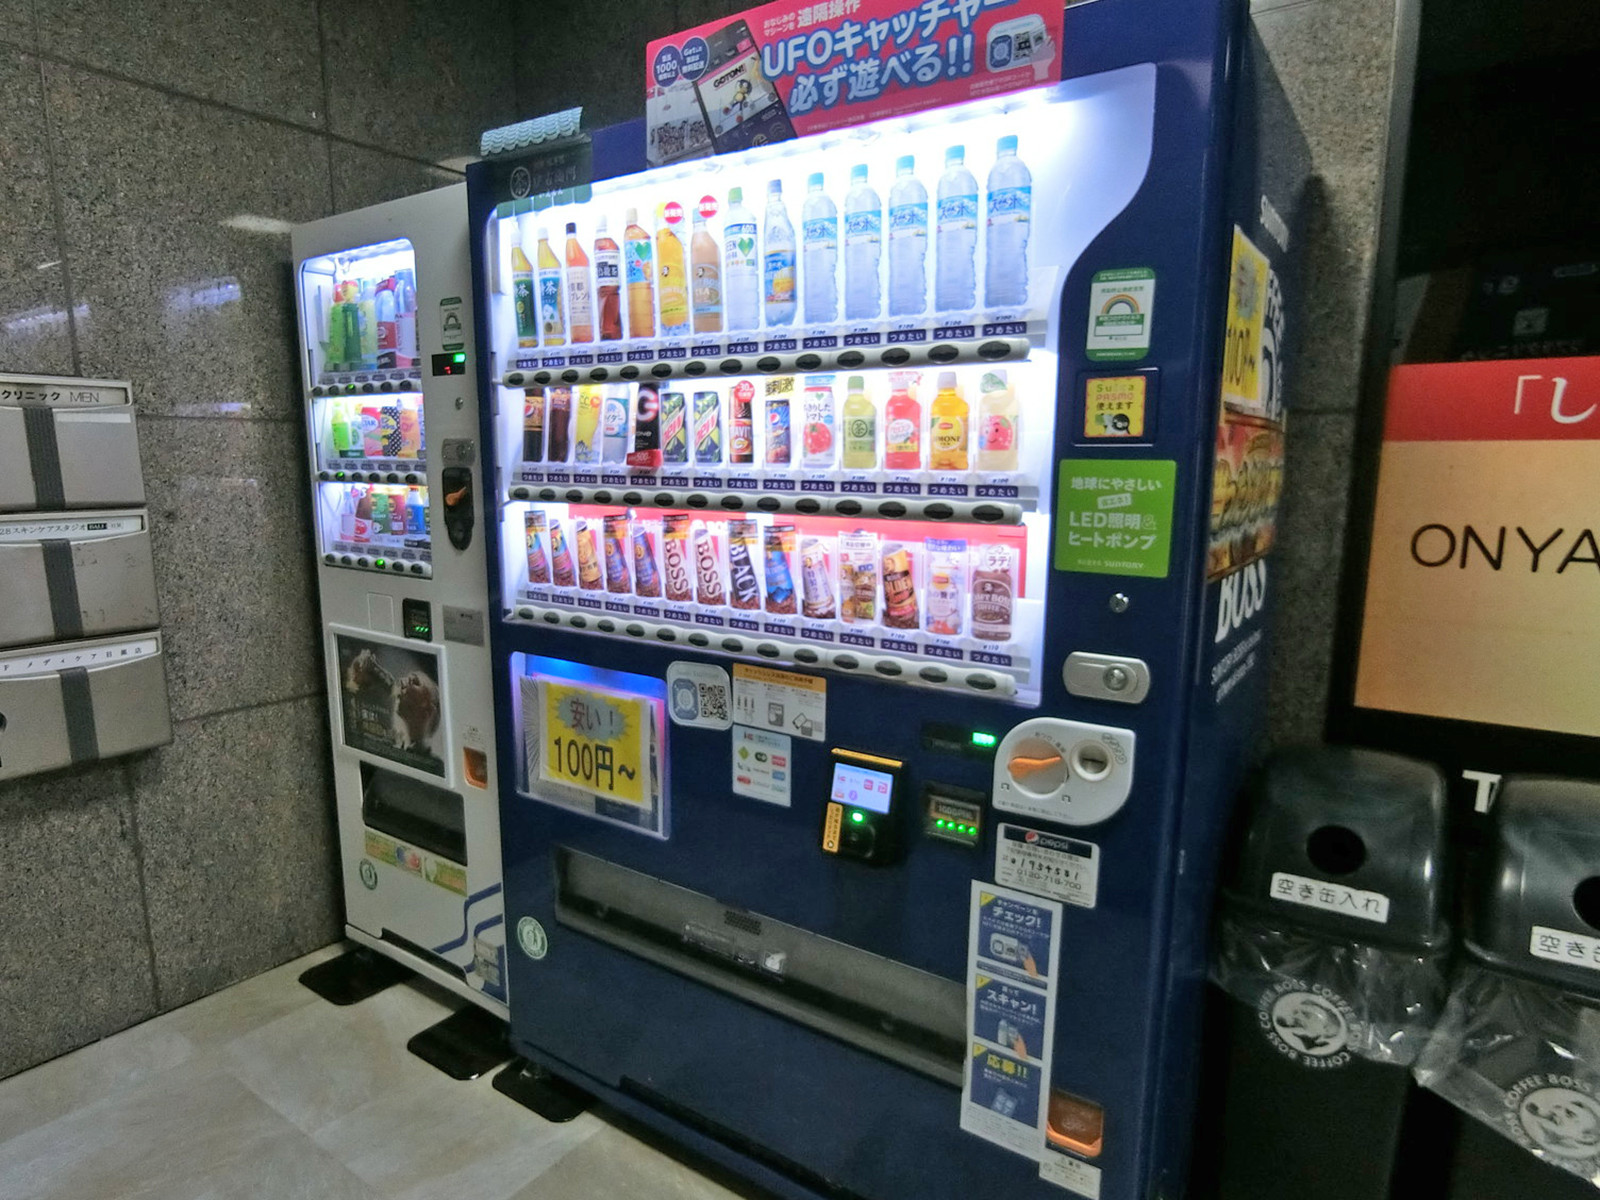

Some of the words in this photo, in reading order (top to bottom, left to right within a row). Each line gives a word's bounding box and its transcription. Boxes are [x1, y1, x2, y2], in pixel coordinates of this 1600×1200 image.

[936, 328, 972, 338] つめたい
[986, 325, 1024, 334] つめたい
[846, 336, 878, 344] つめたい
[889, 332, 924, 341] つめたい
[765, 342, 795, 351] つめたい
[805, 339, 835, 347] つめたい
[693, 347, 719, 356] つめたい
[729, 344, 756, 353] つめたい
[628, 352, 652, 361] つめたい
[660, 349, 685, 358] つめたい
[2, 390, 61, 401] クリニック
[70, 391, 100, 403] MEN
[1096, 402, 1134, 411] 使えます
[663, 478, 687, 486] つめたい
[695, 479, 721, 487] つめたい
[729, 480, 756, 488] つめたい
[765, 481, 794, 489] つめたい
[803, 482, 833, 490] つめたい
[1070, 476, 1163, 491] 地球にやさしい
[843, 483, 874, 492] つめたい
[886, 485, 918, 493] つめたい
[931, 486, 966, 494] つめたい
[978, 487, 1015, 497] つめたい
[1068, 531, 1157, 550] ヒートポンプ
[1411, 523, 1600, 574] ONYA
[665, 540, 689, 592] BOSS
[1104, 560, 1145, 568] SUNTORY
[696, 541, 723, 599] BOSS
[665, 611, 690, 620] つめたい
[697, 615, 722, 625] つめたい
[731, 620, 758, 629] つめたい
[766, 625, 794, 634] つめたい
[803, 630, 832, 639] つめたい
[842, 635, 873, 645] つめたい
[883, 641, 915, 651] つめたい
[927, 647, 960, 657] つめたい
[973, 653, 1009, 664] つめたい
[570, 698, 615, 735] 安い!
[1276, 876, 1381, 914] 空き缶入れ
[992, 906, 1042, 928] チェック!
[987, 988, 1037, 1016] スキャン!
